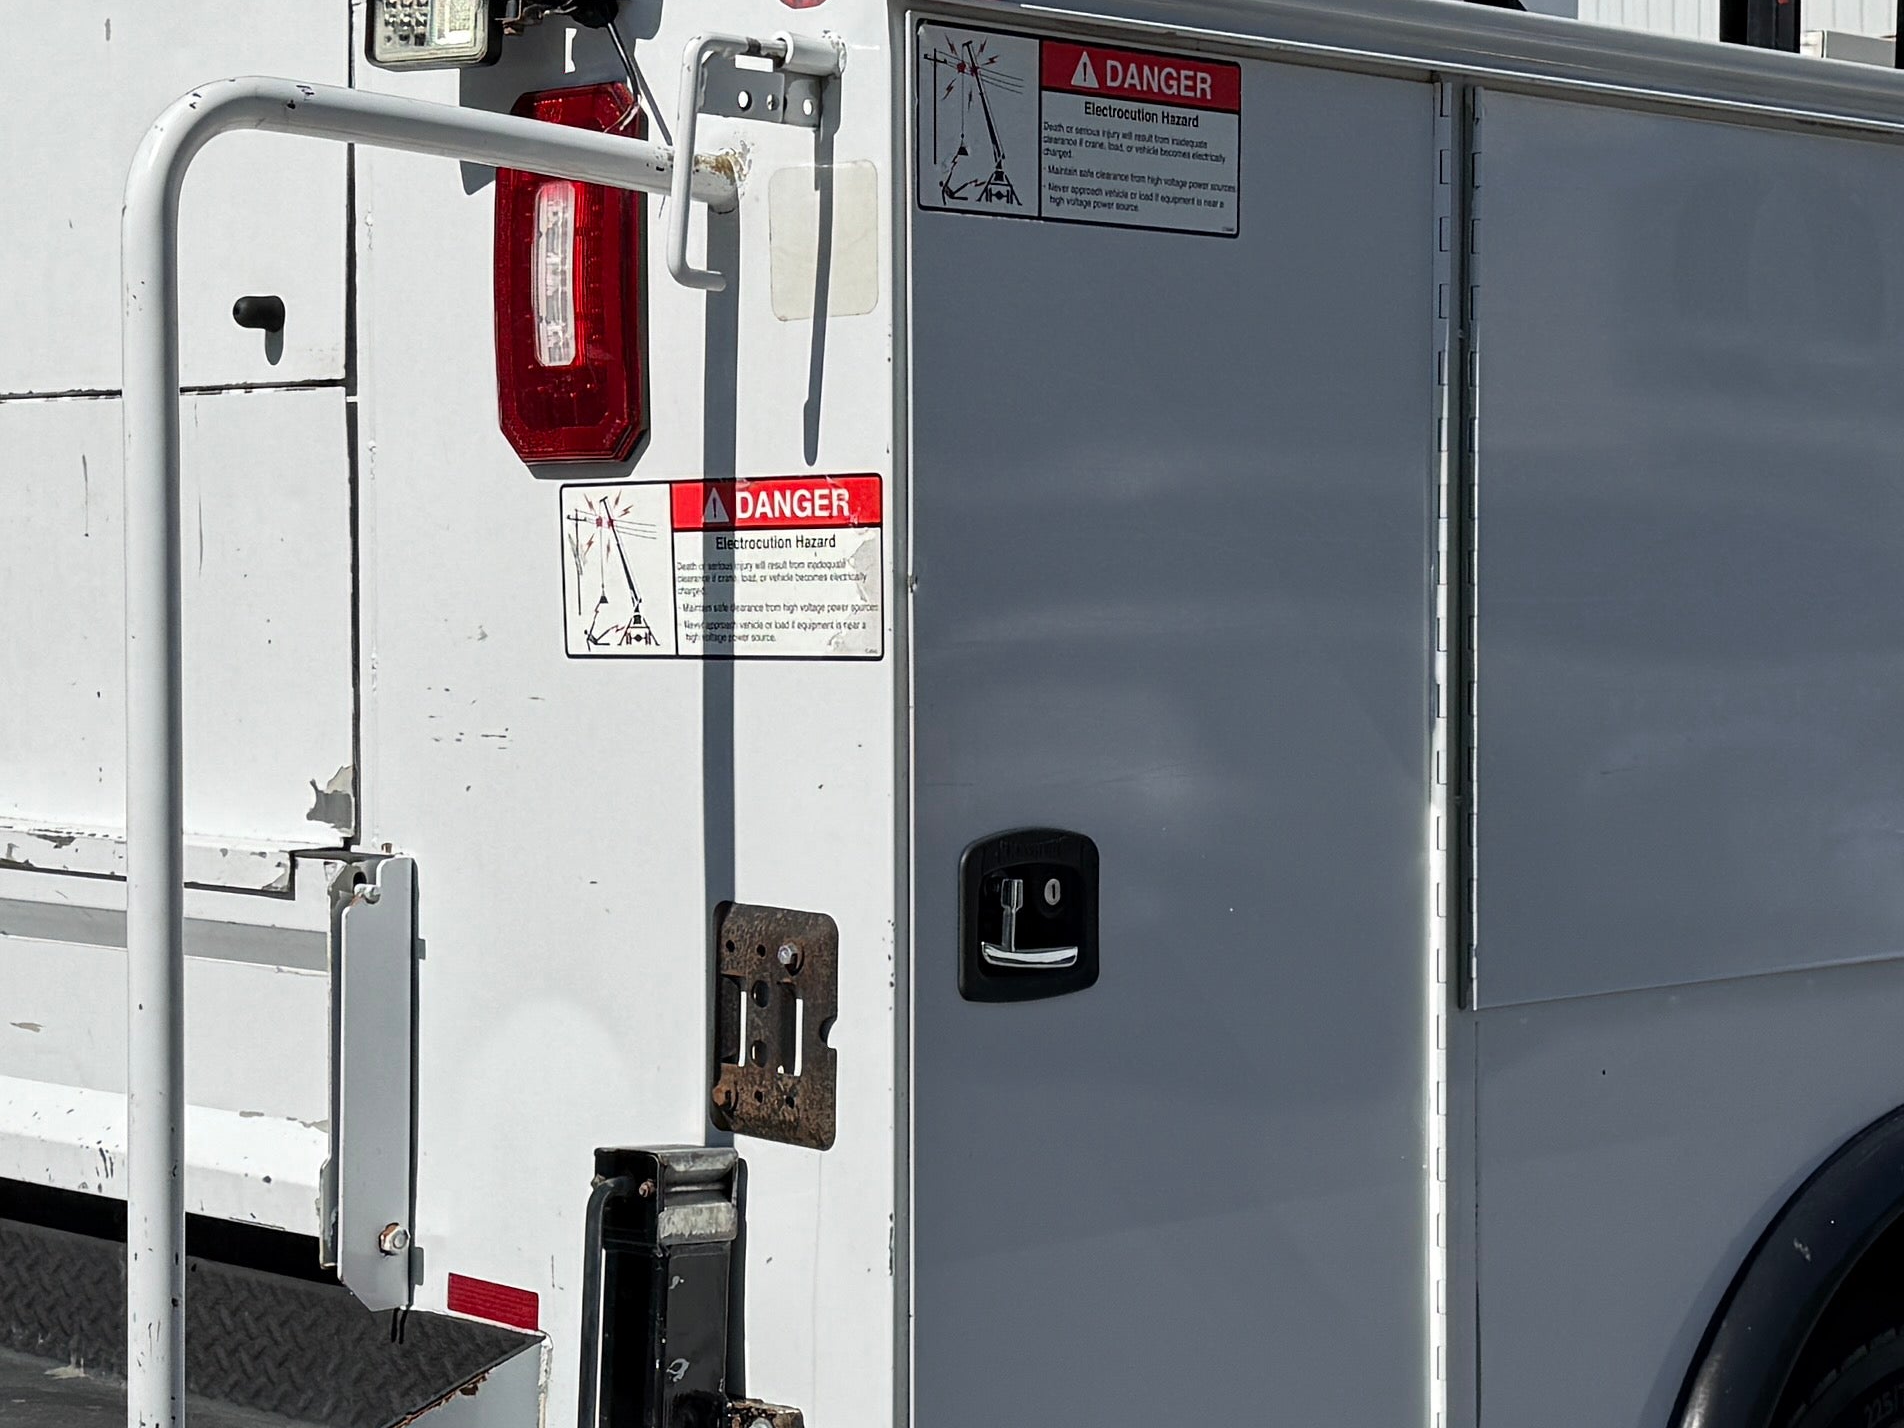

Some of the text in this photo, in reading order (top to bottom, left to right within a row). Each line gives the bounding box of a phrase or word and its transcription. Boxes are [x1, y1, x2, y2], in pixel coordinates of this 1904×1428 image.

[1106, 59, 1212, 100] DANGER
[1084, 101, 1199, 128] Electrocution Hazard
[735, 488, 850, 519] DANGER
[716, 534, 836, 551] Electrocution Hazard
